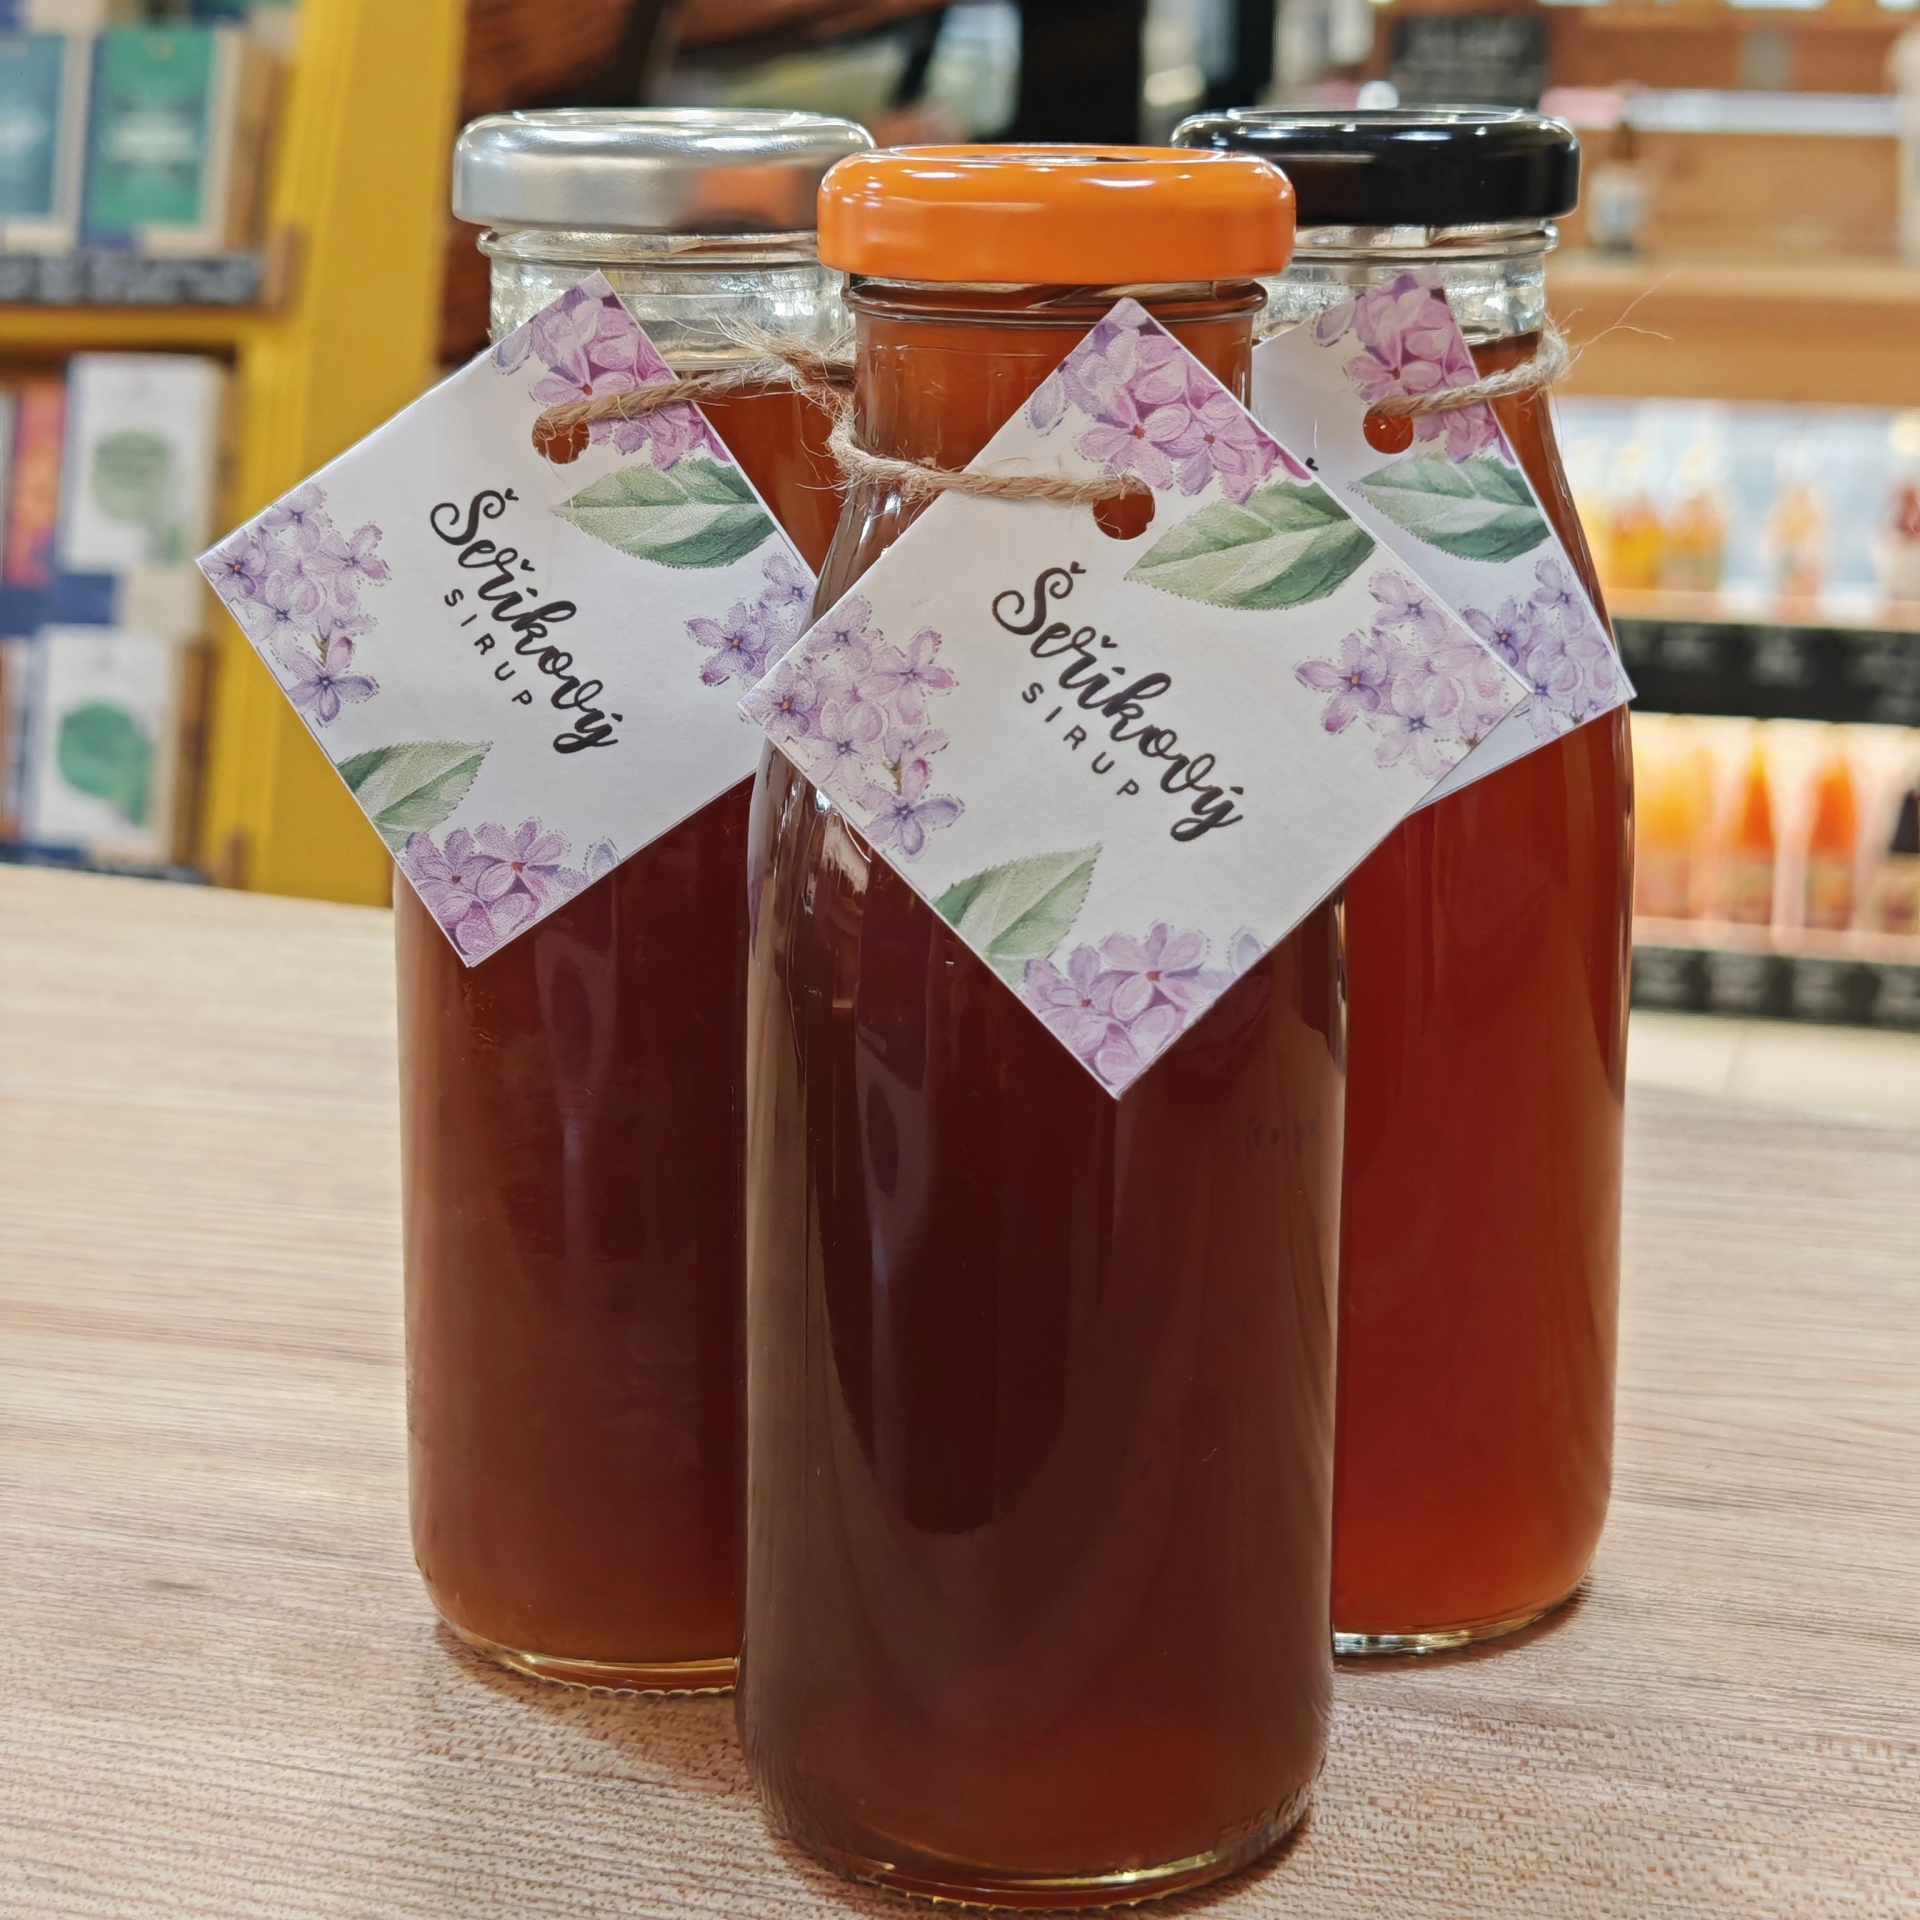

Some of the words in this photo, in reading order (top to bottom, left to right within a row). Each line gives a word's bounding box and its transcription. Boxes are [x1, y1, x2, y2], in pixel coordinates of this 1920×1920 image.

[430, 488, 624, 755] Šeříkový
[444, 588, 533, 706] SIRUP
[992, 561, 1245, 842] Šeříkový
[1021, 682, 1140, 797] SIRUP
